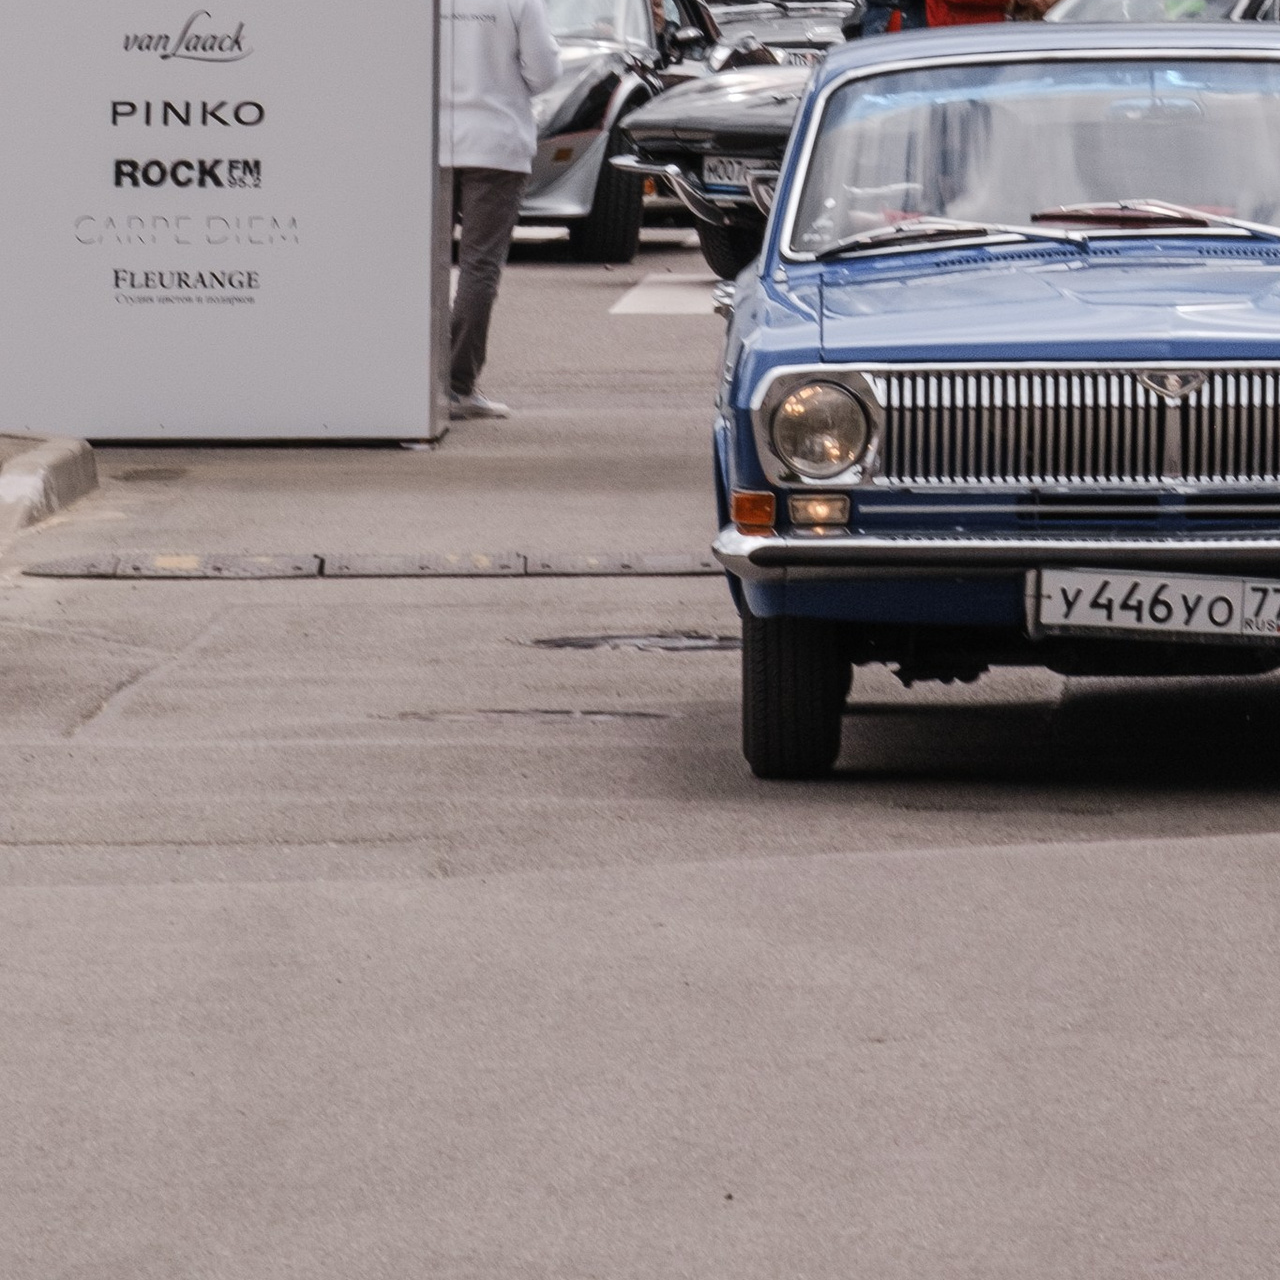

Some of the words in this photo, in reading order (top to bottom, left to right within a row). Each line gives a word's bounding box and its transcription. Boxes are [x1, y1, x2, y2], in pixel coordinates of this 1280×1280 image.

[122, 32, 170, 52] van
[111, 100, 265, 127] PINKO
[114, 159, 224, 188] ROCK
[228, 159, 261, 177] FM
[113, 269, 259, 289] FLEURANGE
[1244, 617, 1277, 633] RUS
